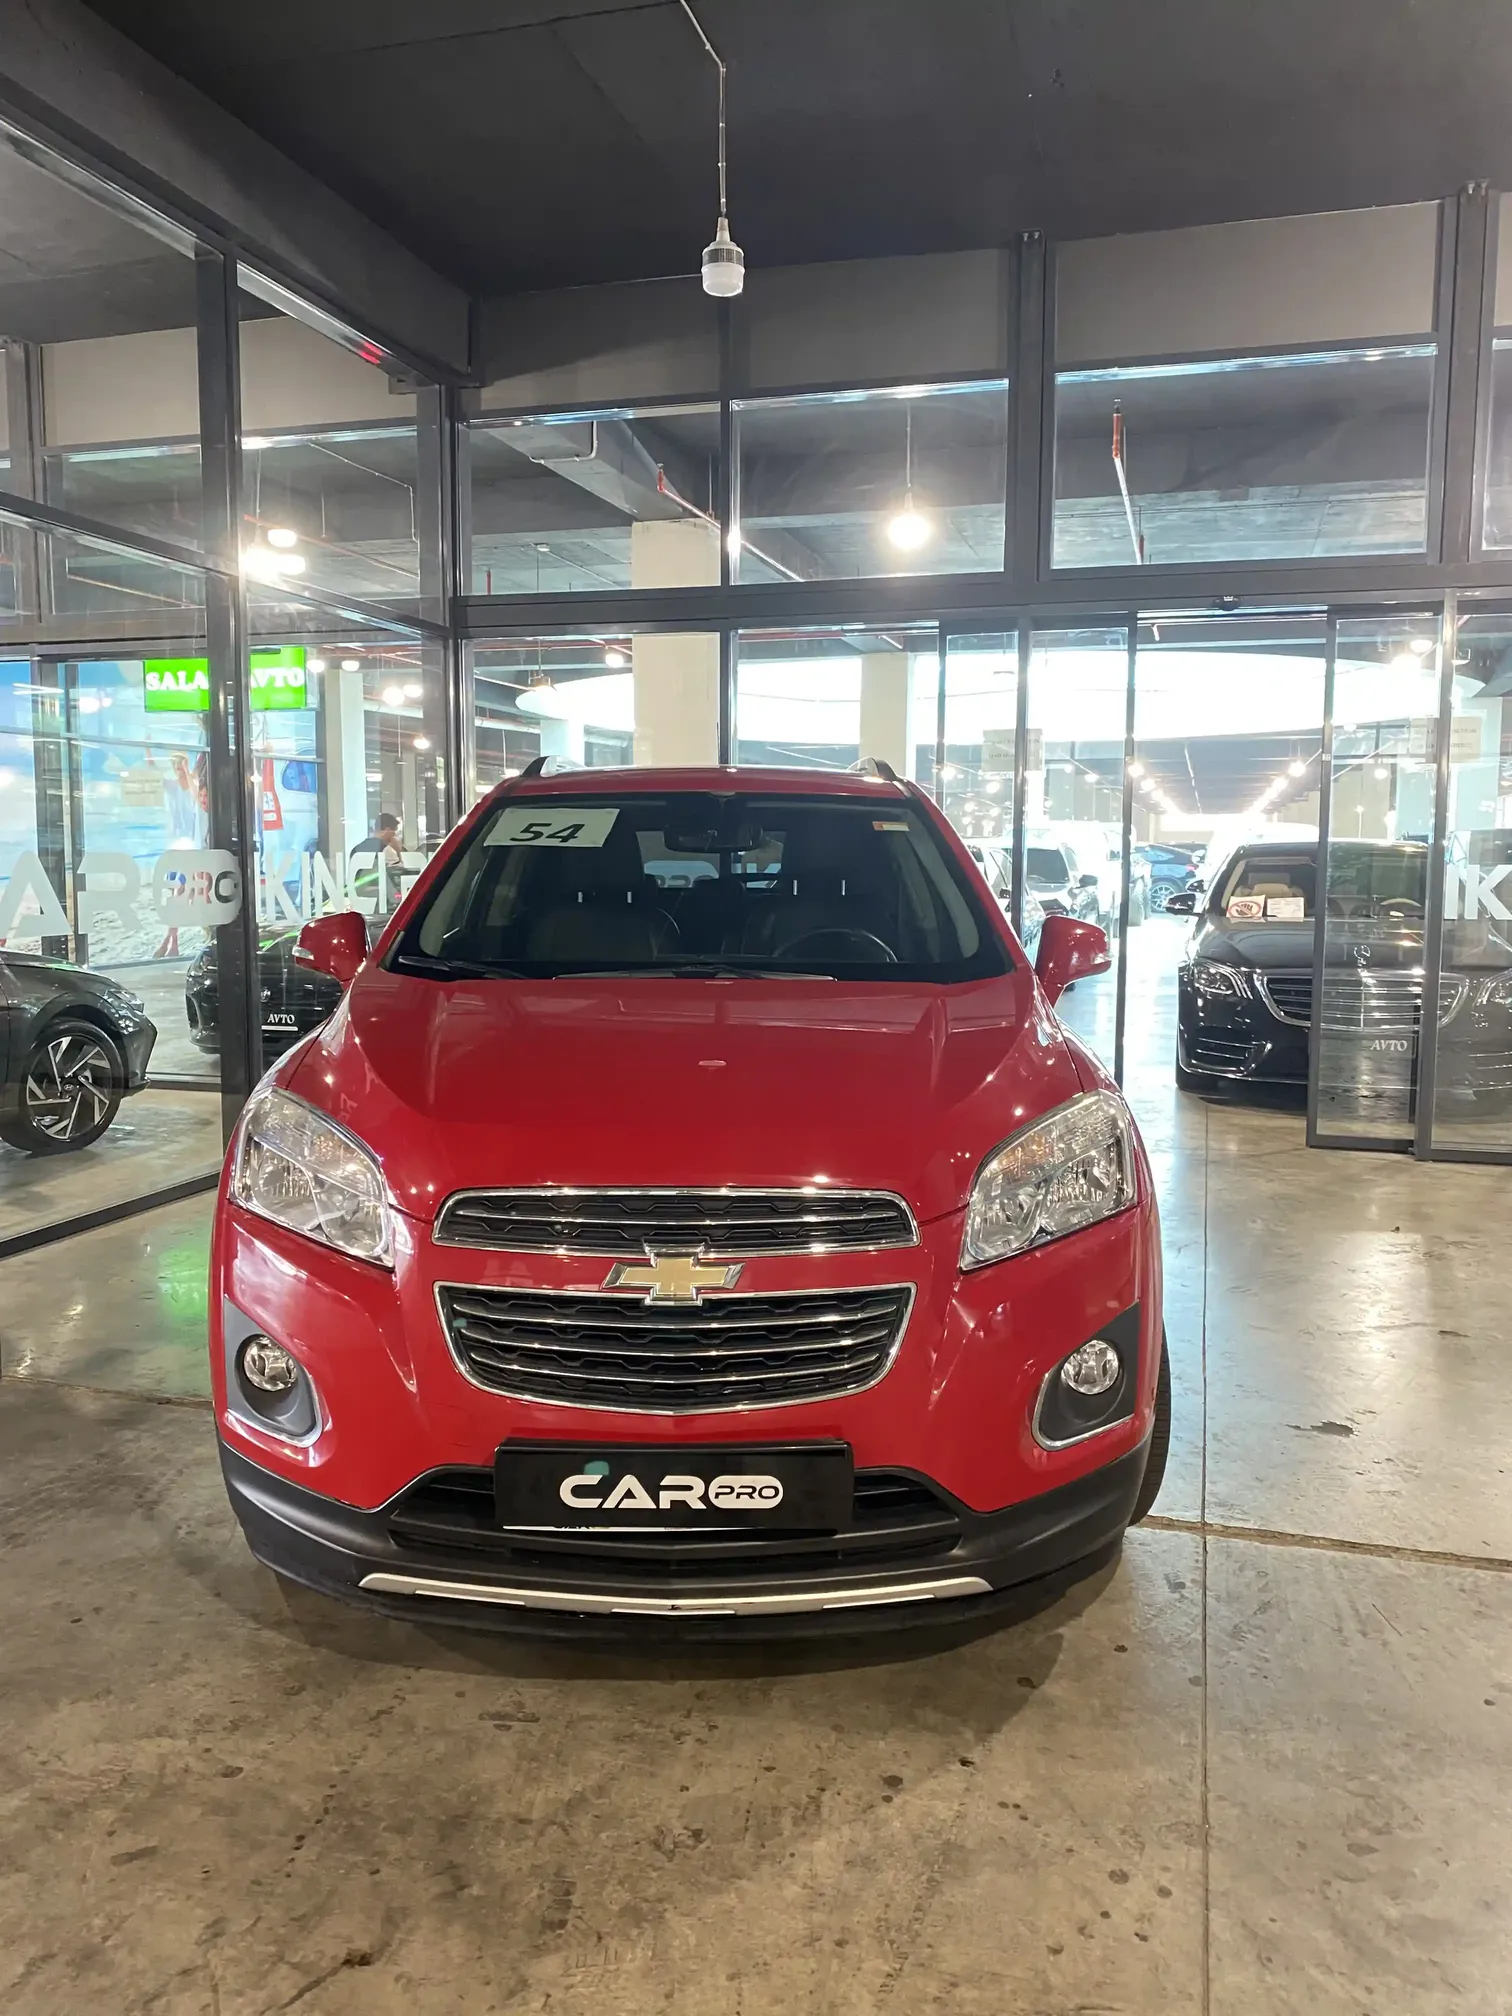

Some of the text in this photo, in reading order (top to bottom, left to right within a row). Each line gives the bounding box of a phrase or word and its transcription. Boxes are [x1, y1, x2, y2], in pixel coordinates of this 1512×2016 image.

[145, 667, 305, 692] SALA AVTO
[509, 822, 585, 843] 54
[267, 1013, 296, 1024] AVTO
[1370, 1039, 1408, 1052] AVTO
